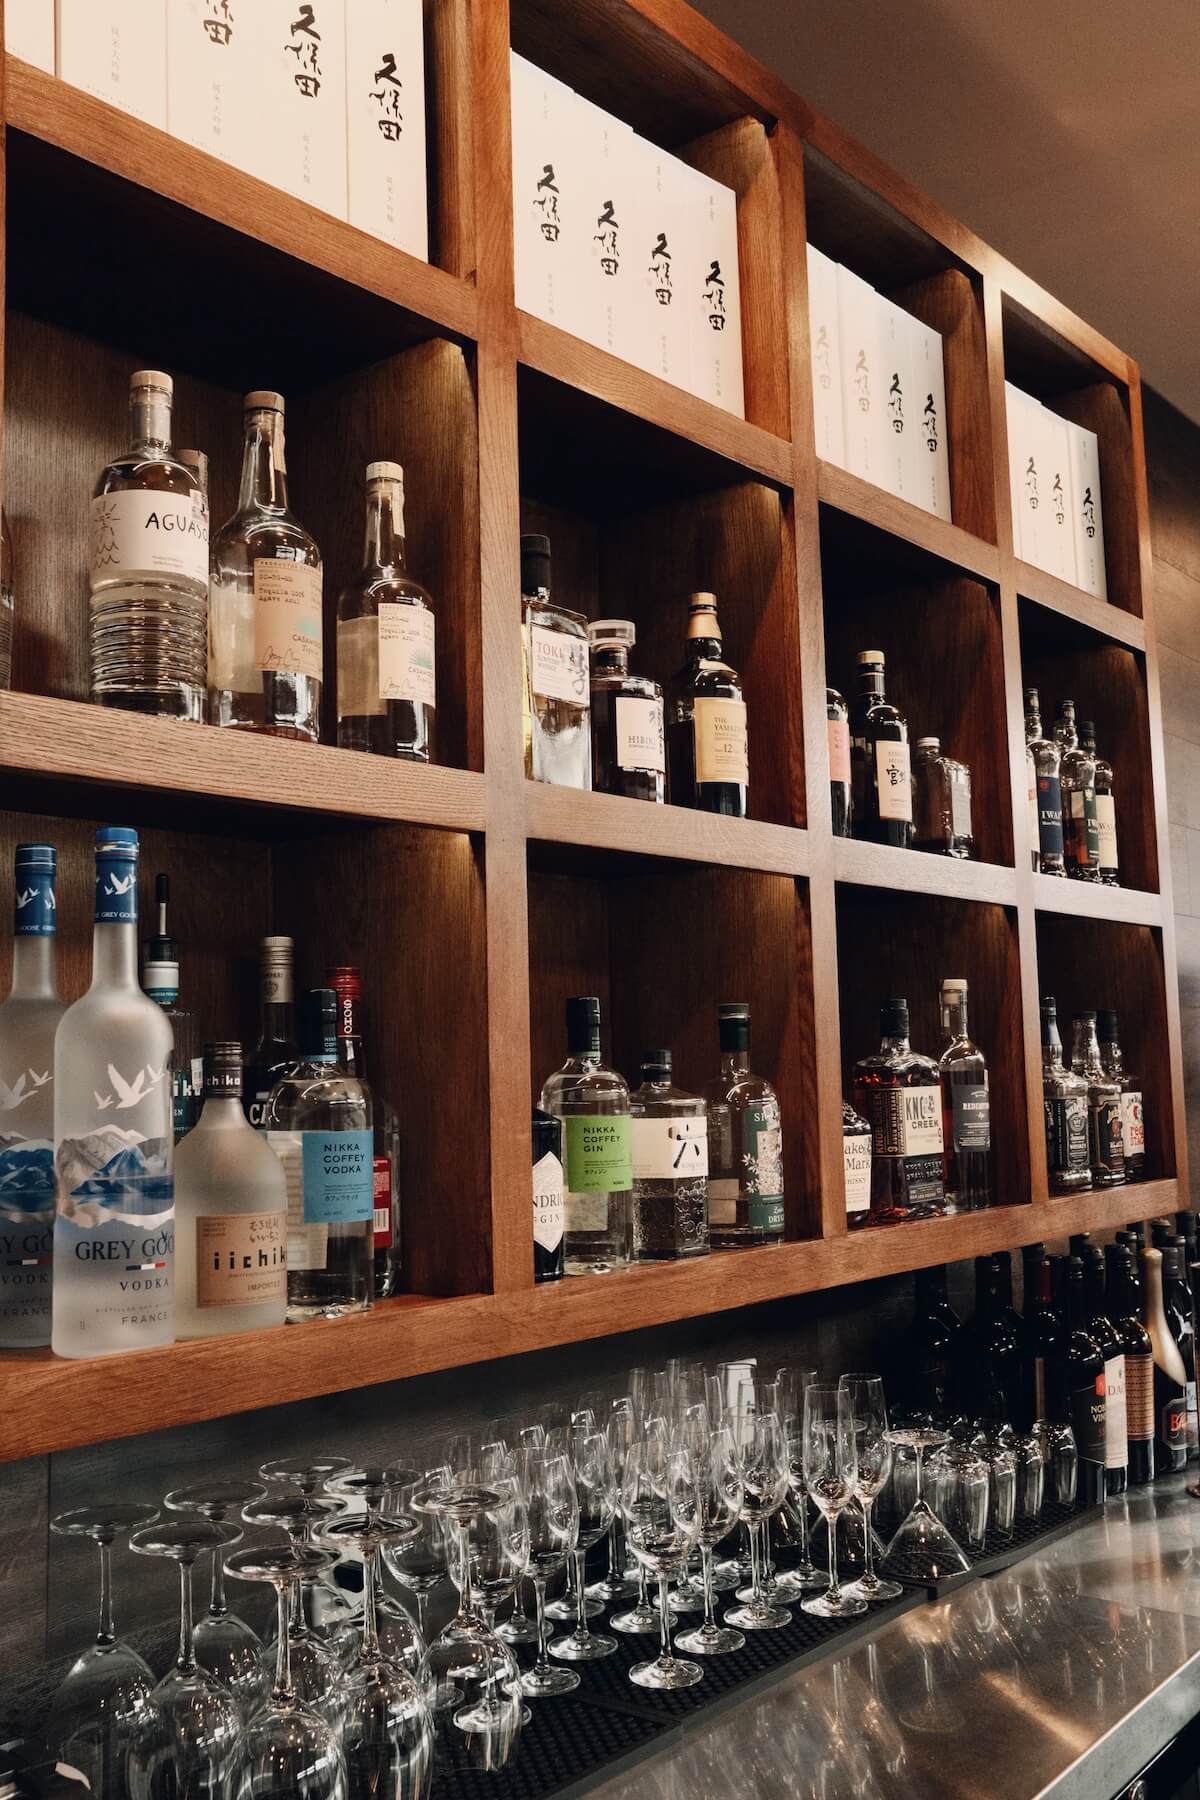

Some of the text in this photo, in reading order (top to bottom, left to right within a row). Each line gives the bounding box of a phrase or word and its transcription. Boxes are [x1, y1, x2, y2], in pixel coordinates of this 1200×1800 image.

[284, 4, 321, 98] 久保田
[368, 53, 403, 142] 久保田
[533, 164, 560, 242] 久保田
[593, 200, 619, 276] 久保田
[648, 233, 672, 306] 久保田
[702, 260, 725, 331] 久保田
[888, 372, 903, 433] 久保田
[922, 393, 937, 452] 久保田
[1025, 456, 1038, 509] 久保田
[1052, 473, 1064, 525] 久保田
[1082, 487, 1095, 537] 久保田
[723, 743, 733, 753] 12
[343, 1000, 352, 1034] SOHO
[583, 1135, 621, 1143] COFFEY
[911, 1119, 939, 1129] CREEK
[323, 1154, 365, 1163] COFFEY
[324, 1143, 360, 1152] NIKKA
[583, 1145, 604, 1153] GIN
[323, 1166, 362, 1175] VODKA
[75, 1240, 136, 1261] GREY
[120, 1277, 169, 1292] VODKA
[121, 1311, 168, 1326] FRANCE
